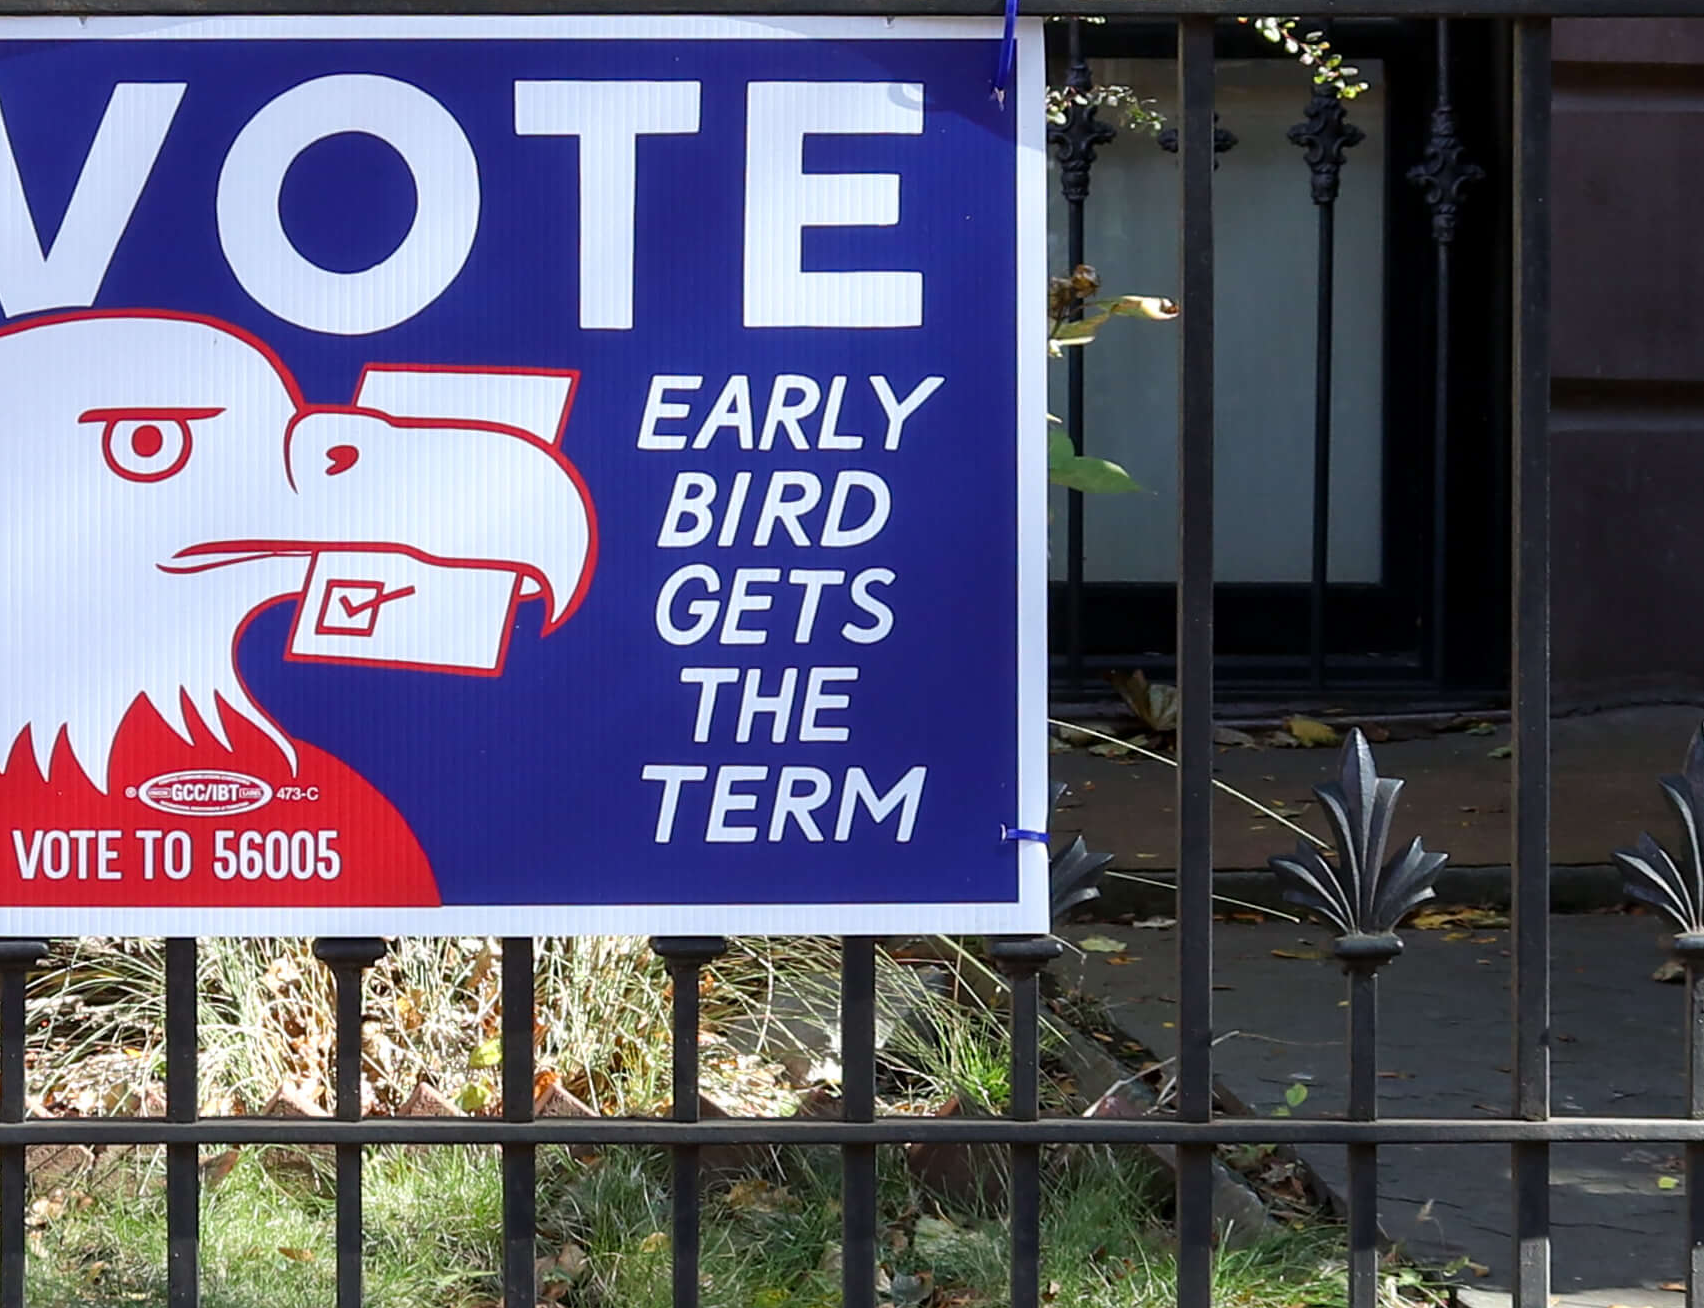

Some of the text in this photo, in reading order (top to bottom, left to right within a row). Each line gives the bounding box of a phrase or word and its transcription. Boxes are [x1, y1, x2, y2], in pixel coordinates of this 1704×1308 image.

[636, 374, 946, 452] EARLY
[656, 470, 892, 549] BIRD
[654, 564, 897, 647] GETS
[679, 666, 860, 744] THE
[171, 783, 240, 802] GCC/IBT
[276, 786, 319, 800] 473-C
[640, 763, 928, 844] TERM
[11, 829, 123, 880] VOTE
[135, 829, 193, 880] TO
[212, 829, 342, 880] 56005
